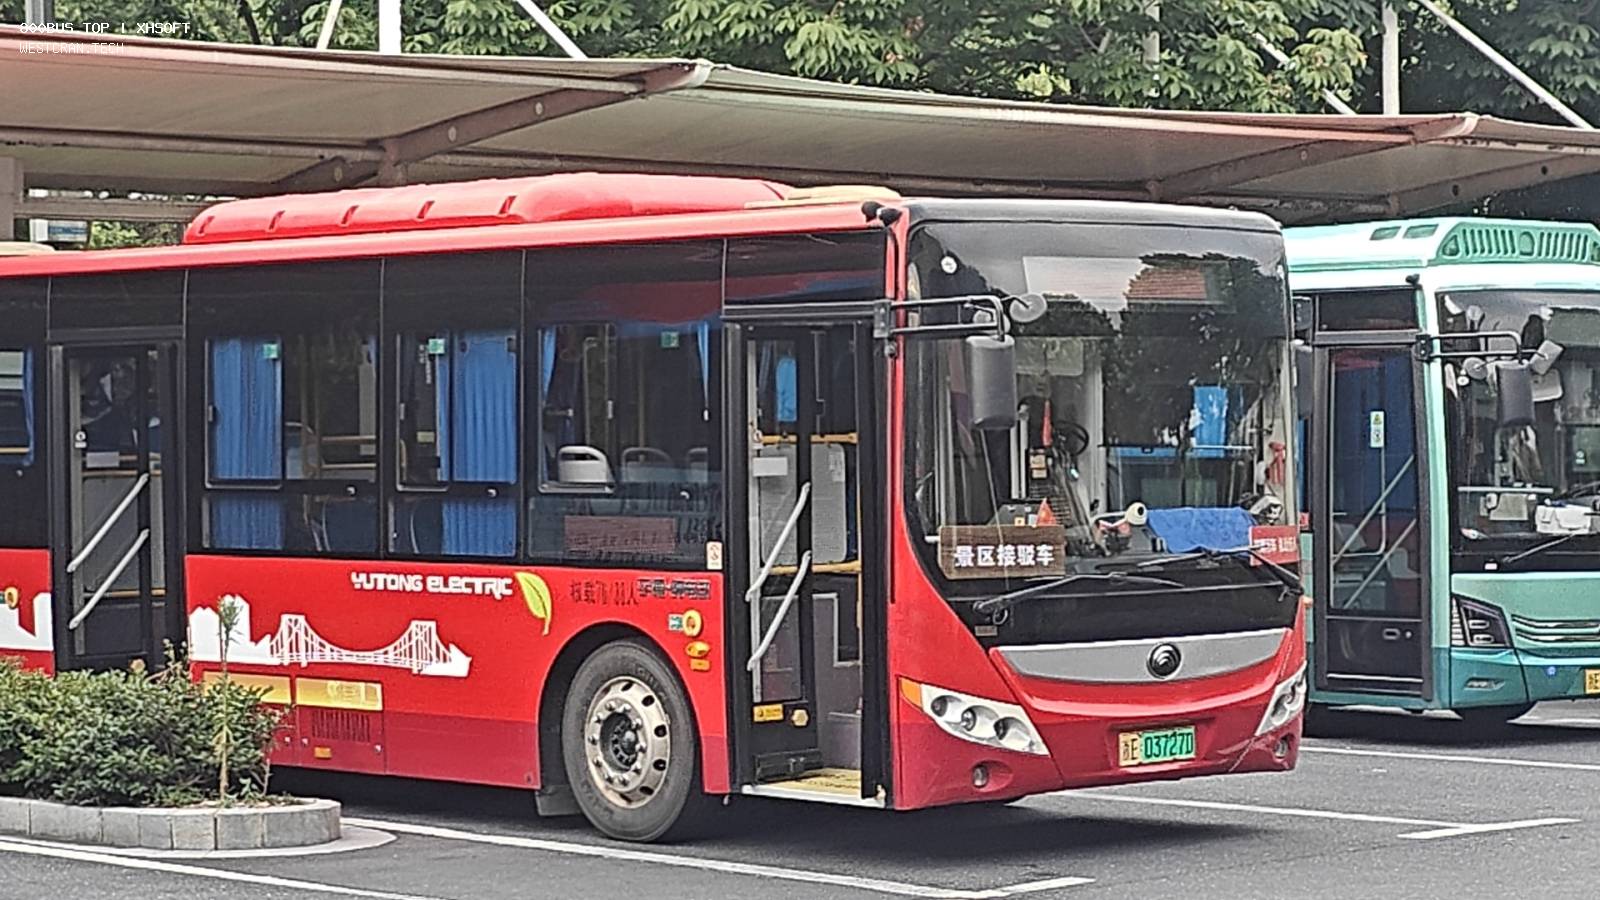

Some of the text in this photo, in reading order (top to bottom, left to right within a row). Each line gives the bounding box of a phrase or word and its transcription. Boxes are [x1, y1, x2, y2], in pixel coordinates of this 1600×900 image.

[953, 544, 1055, 568] 景区接驳车
[351, 572, 423, 592] YUTONG
